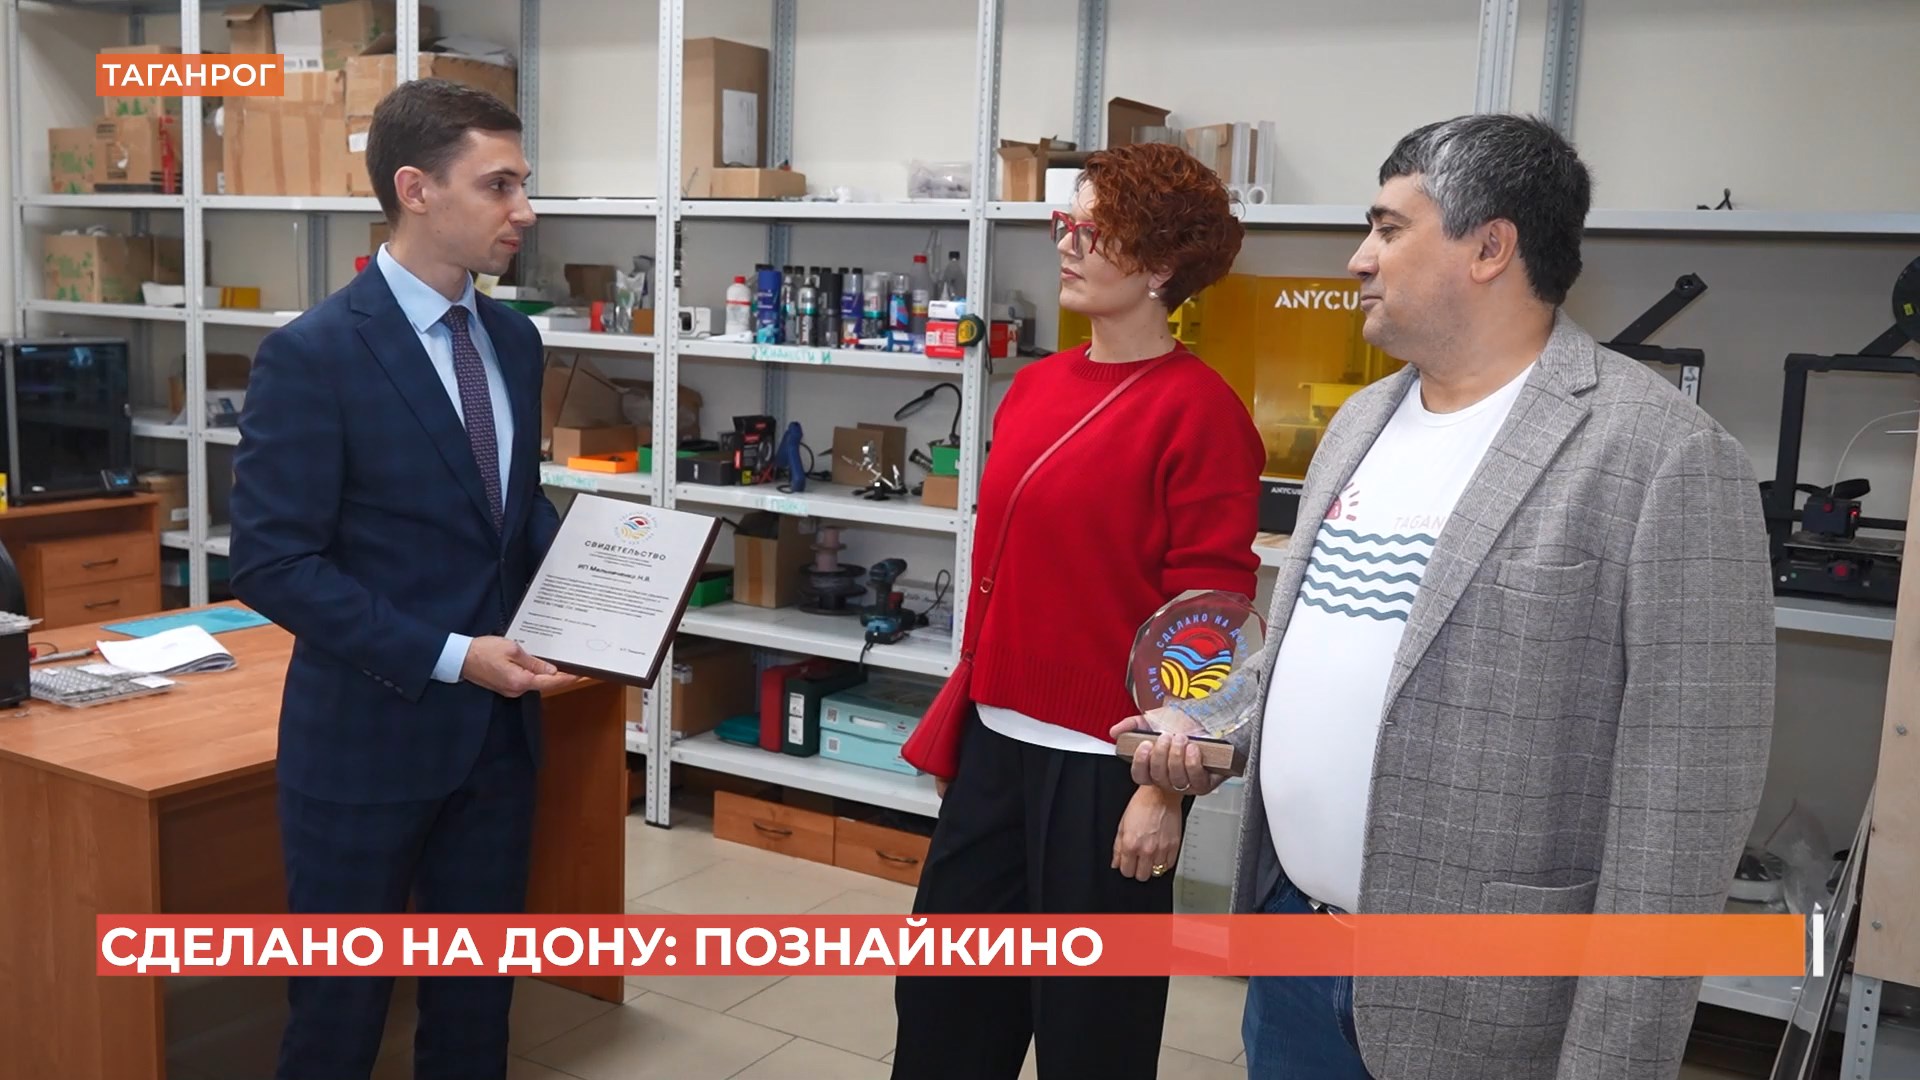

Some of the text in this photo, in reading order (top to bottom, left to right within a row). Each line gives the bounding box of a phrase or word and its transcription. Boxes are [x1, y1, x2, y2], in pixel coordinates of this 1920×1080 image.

[1274, 289, 1360, 311] ANYCU
[1393, 514, 1448, 531] TAGAN
[584, 540, 666, 561] СВИДЕТЕЛЬСТВО
[1156, 613, 1208, 648] СДЕЛАНО
[1214, 615, 1230, 628] НА
[1147, 666, 1165, 701] MADE
